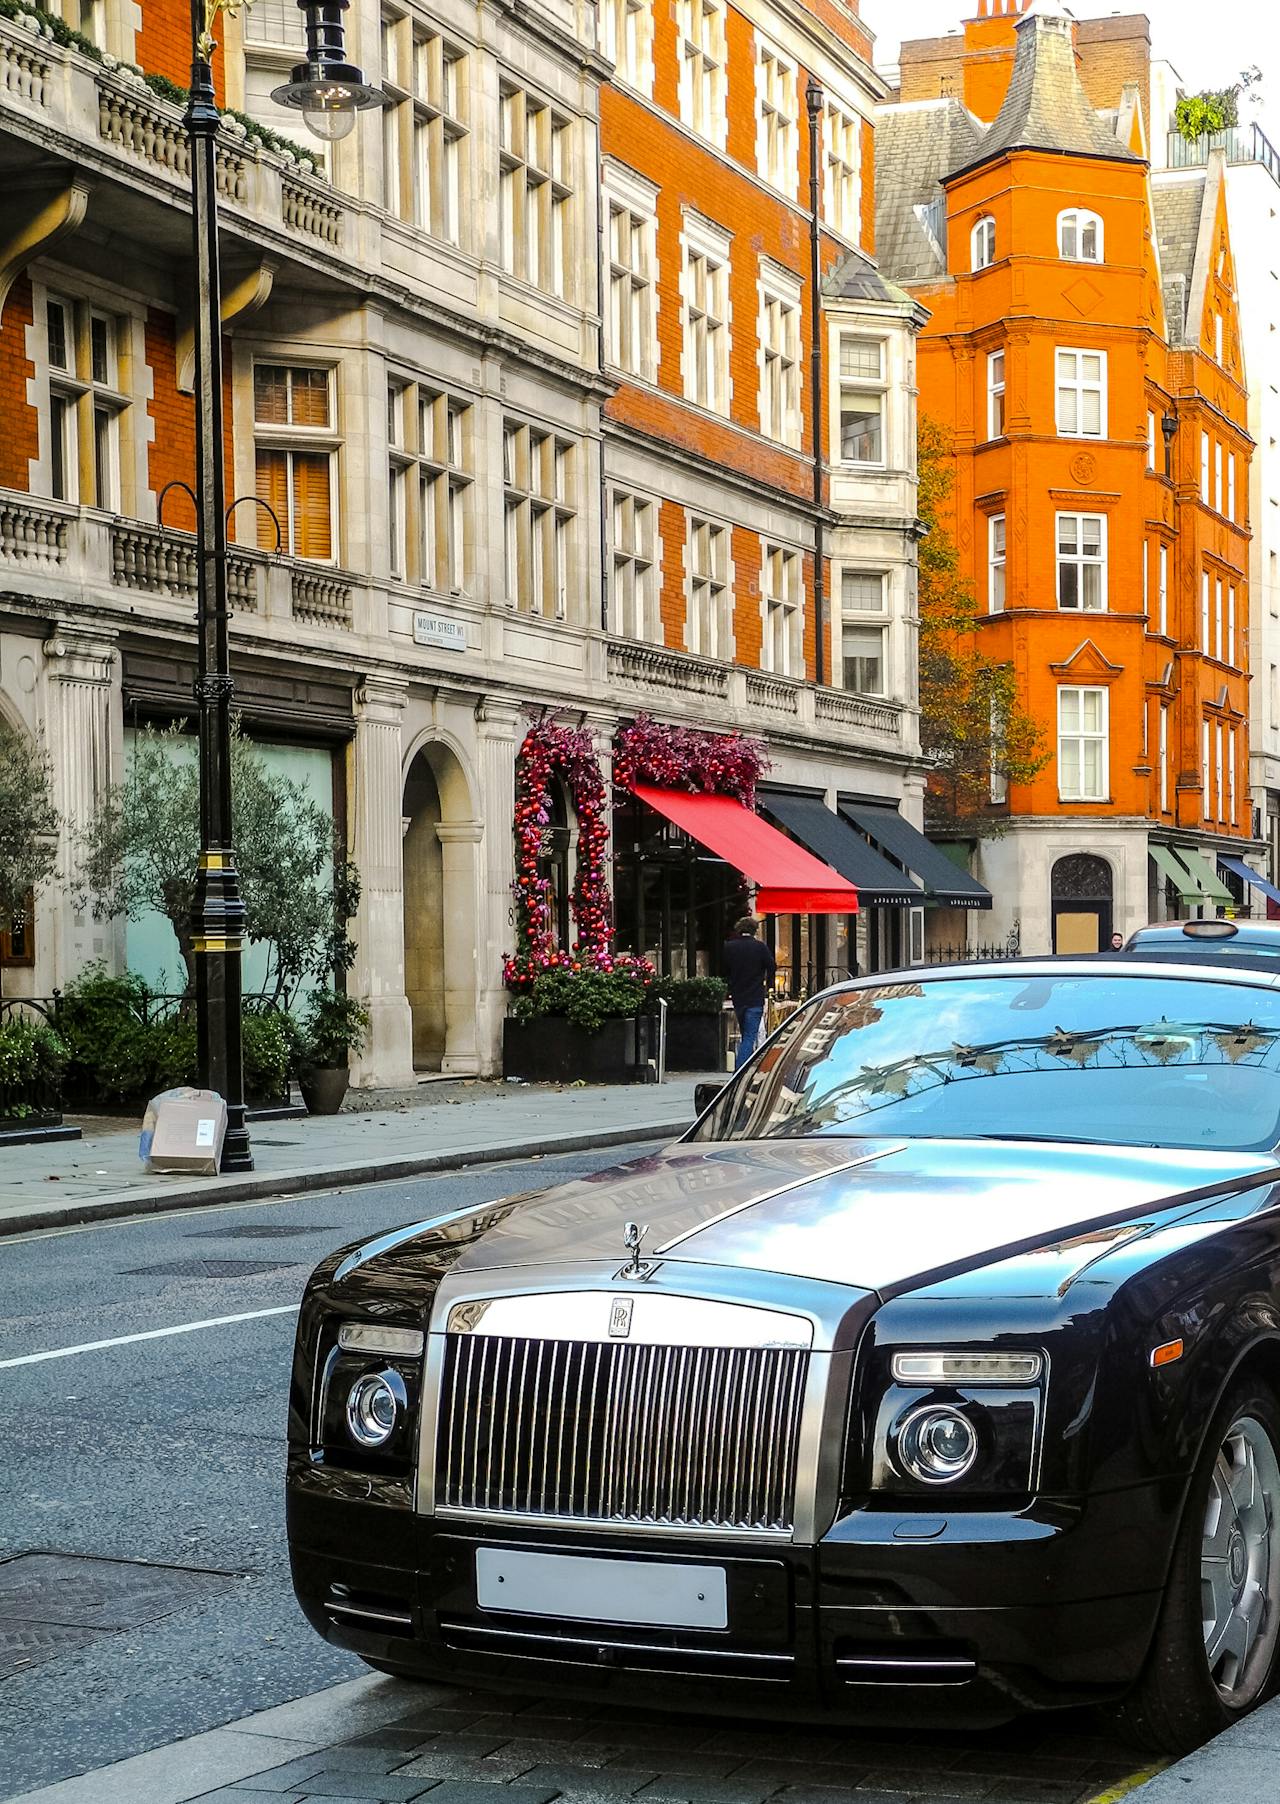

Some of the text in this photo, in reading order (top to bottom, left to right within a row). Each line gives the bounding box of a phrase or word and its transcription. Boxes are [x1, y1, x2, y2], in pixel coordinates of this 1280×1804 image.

[417, 617, 436, 631] MOUNT
[438, 621, 456, 635] STREET
[508, 907, 514, 926] 8
